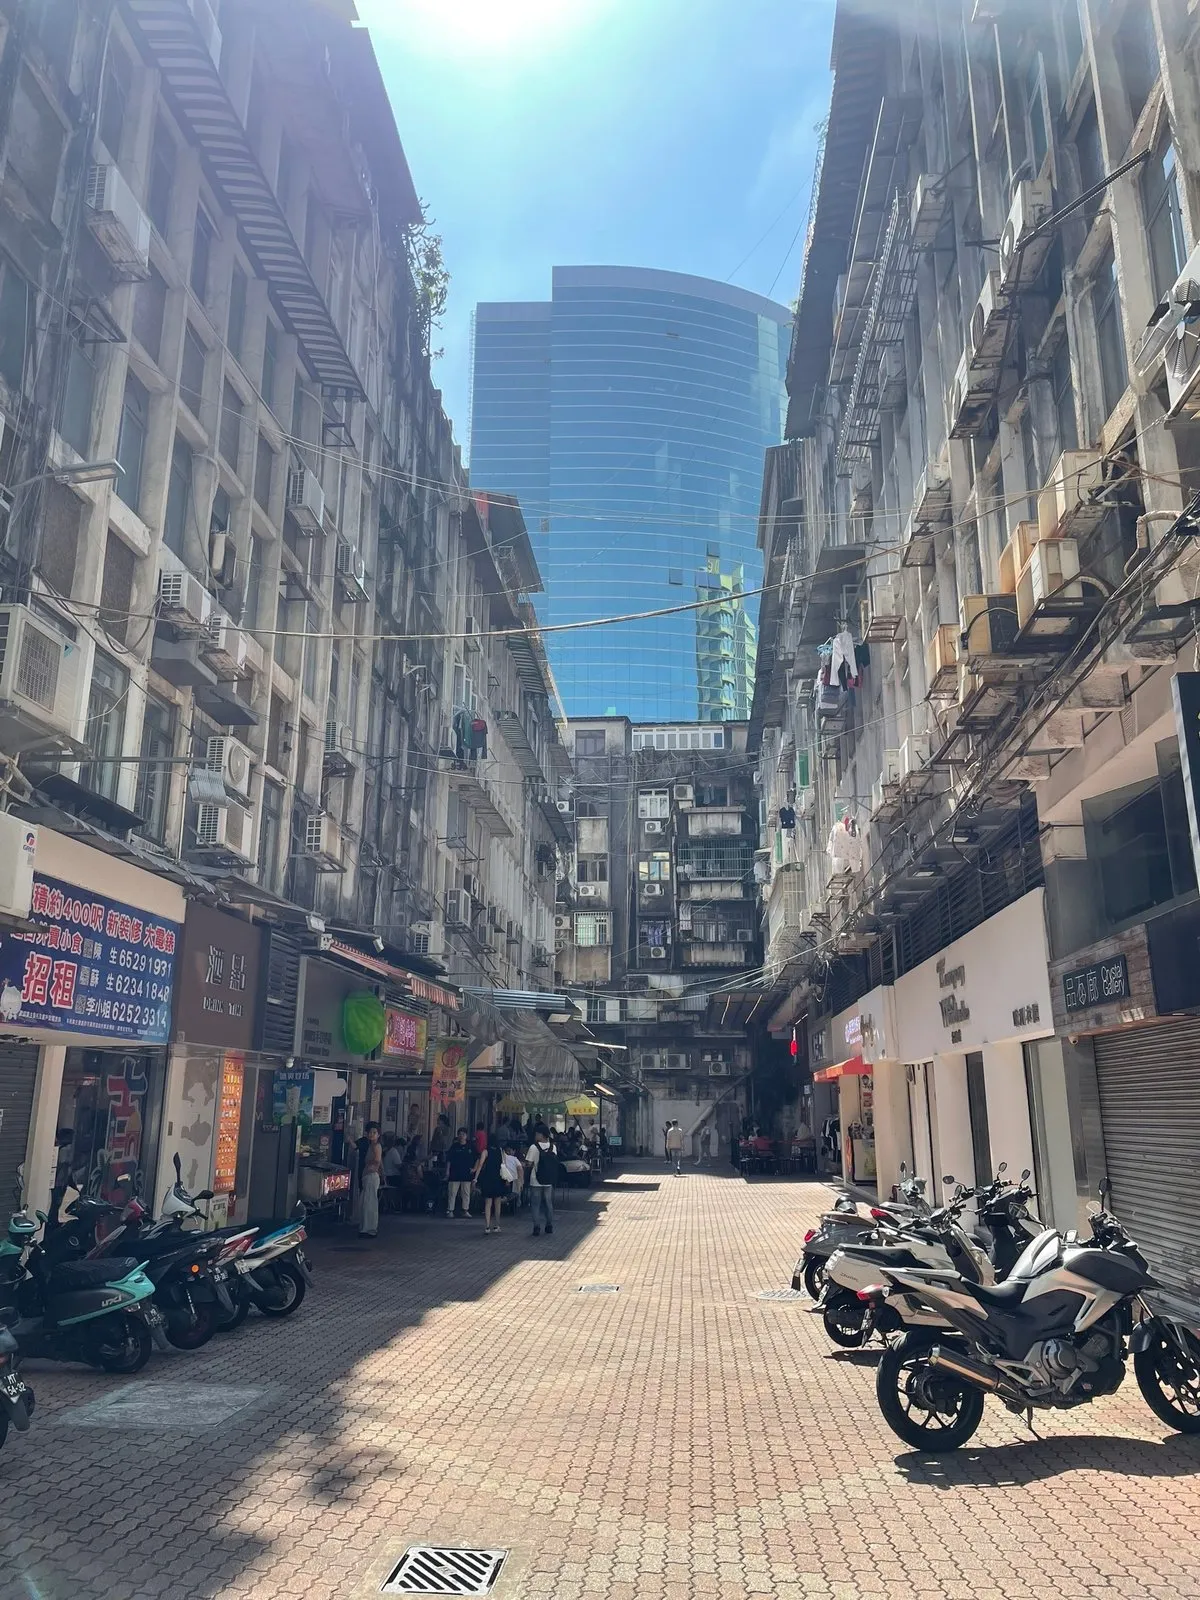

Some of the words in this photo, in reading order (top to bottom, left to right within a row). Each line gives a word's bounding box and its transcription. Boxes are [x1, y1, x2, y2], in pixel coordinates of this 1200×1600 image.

[106, 909, 143, 944] 新裝修
[21, 950, 78, 1009] 招租
[1101, 960, 1123, 983] Crystal
[1103, 978, 1125, 996] Gallery
